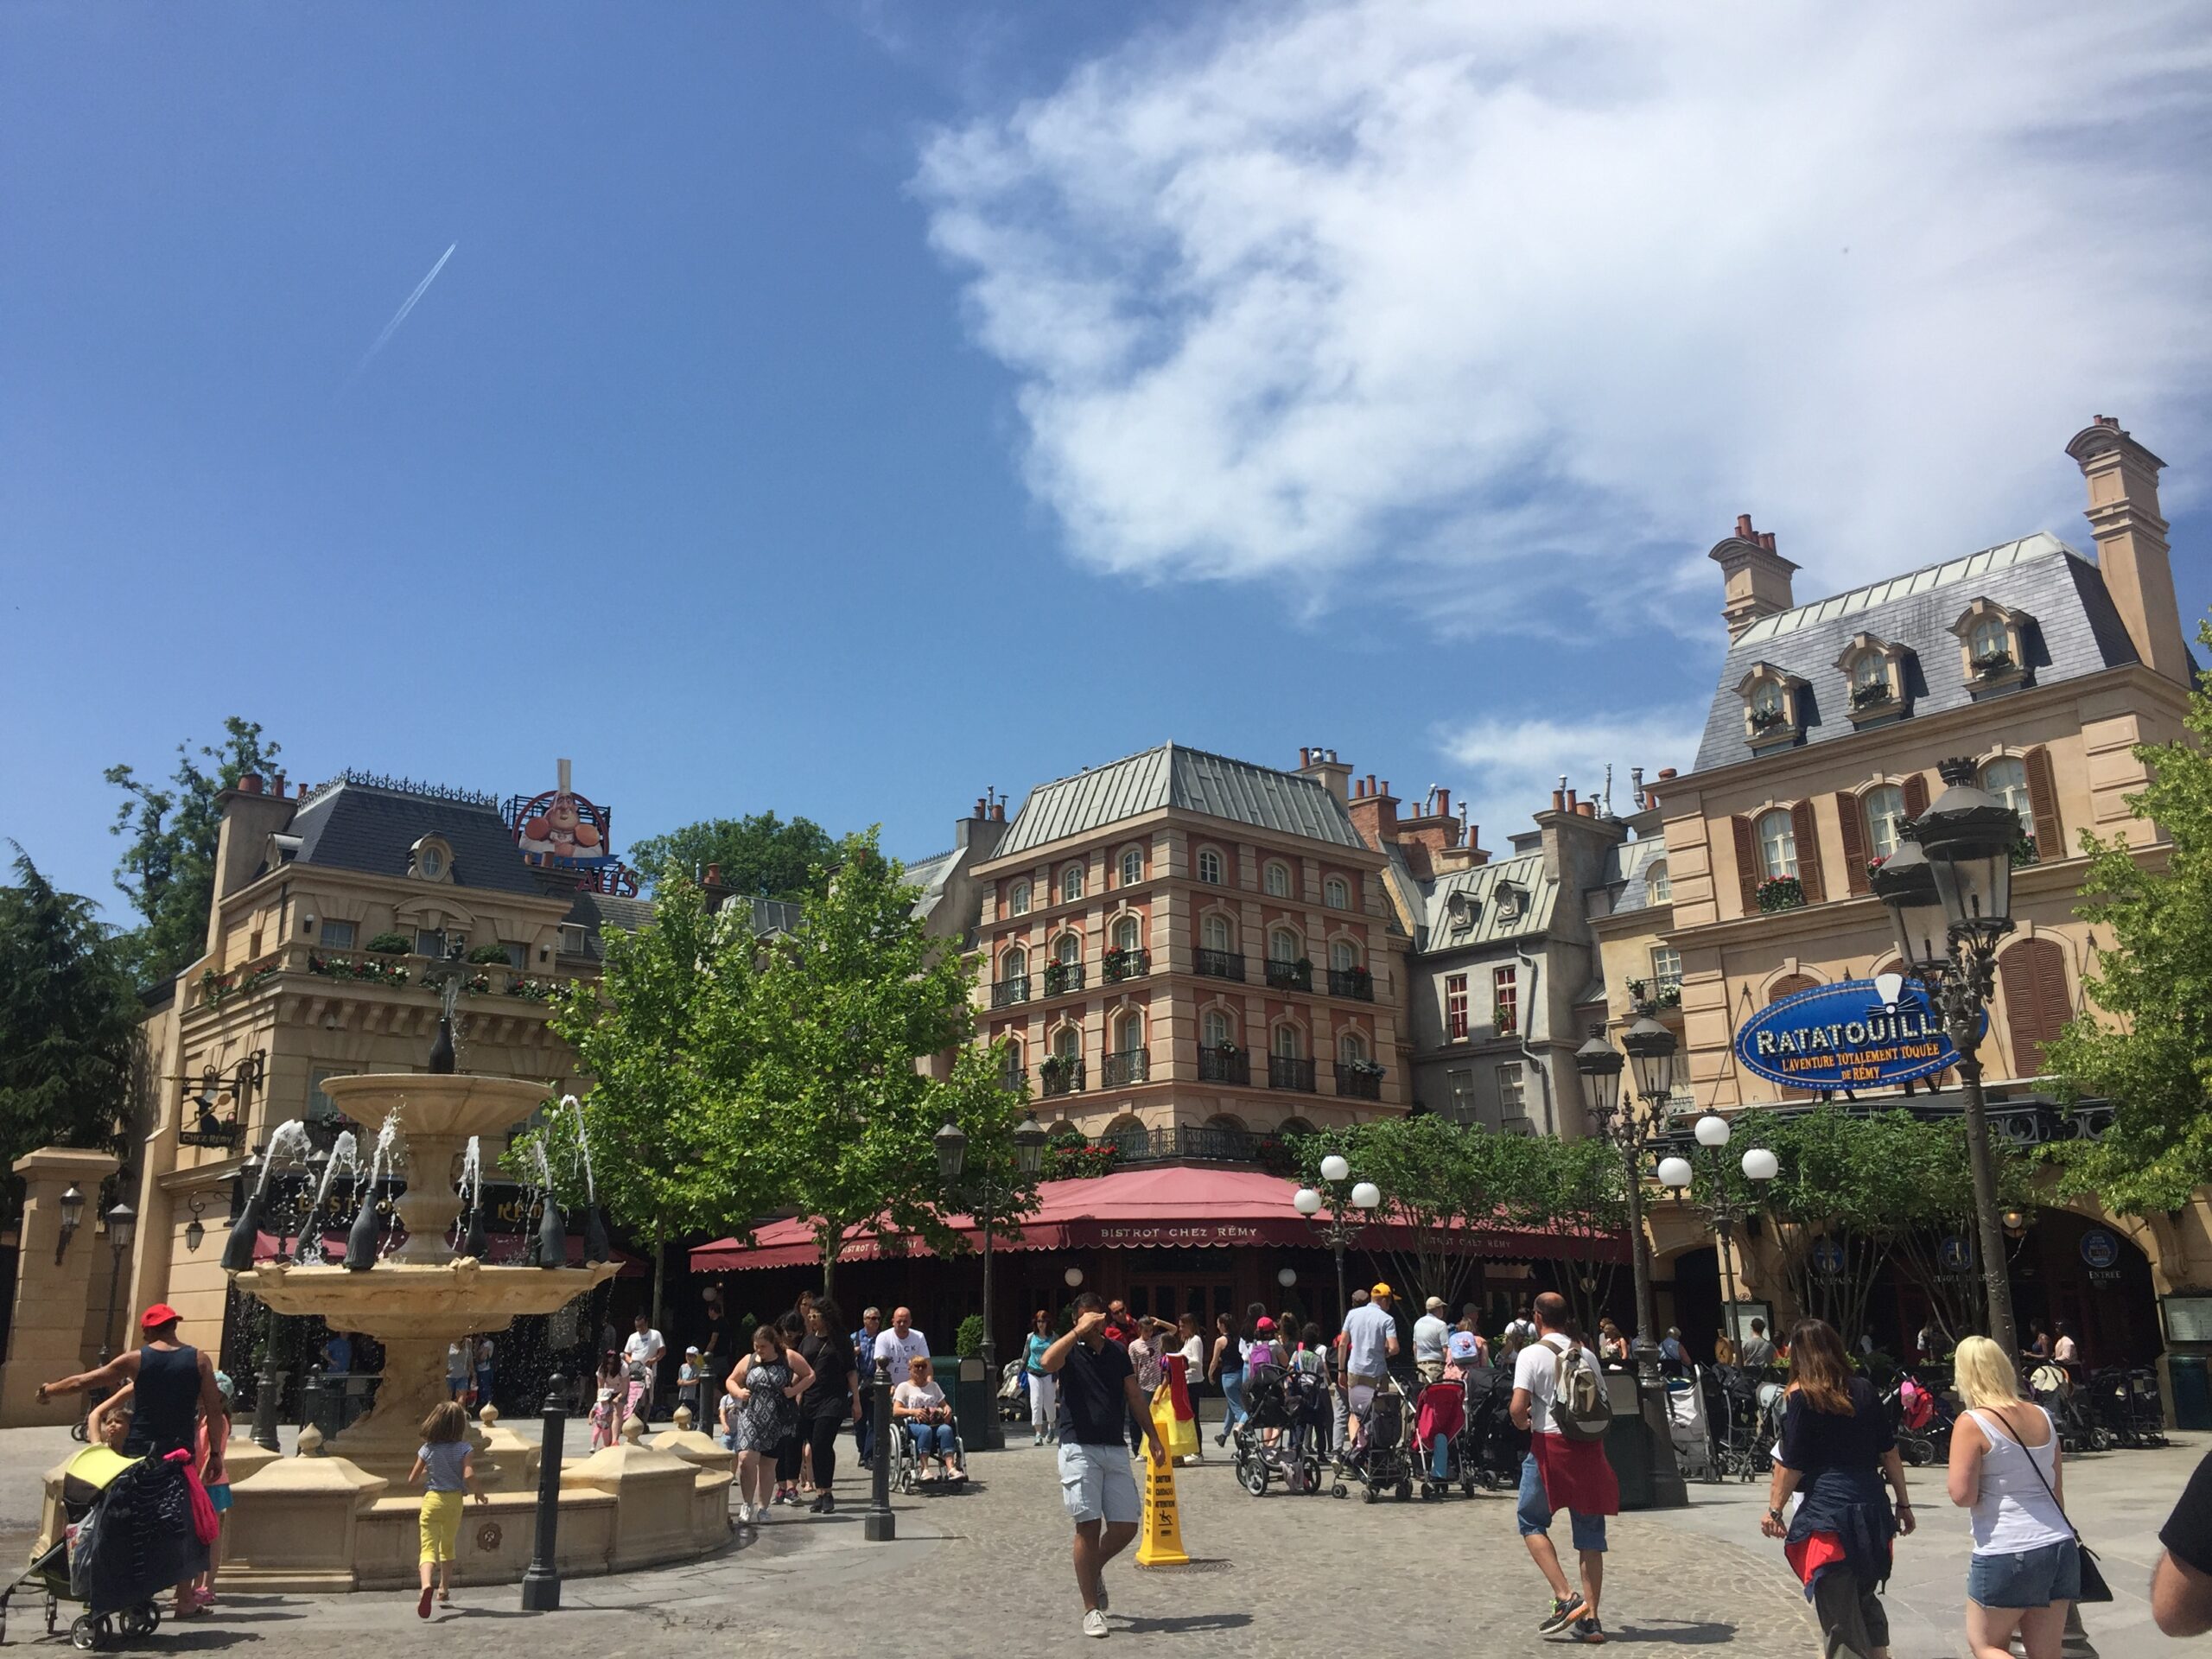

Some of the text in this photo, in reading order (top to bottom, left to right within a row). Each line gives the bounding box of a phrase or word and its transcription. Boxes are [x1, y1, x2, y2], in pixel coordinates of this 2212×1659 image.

[1757, 1013, 1951, 1054] RATATOUILL
[1783, 1040, 1940, 1072] L'AVENTURE TOTALEMENT TOQUÉE
[1853, 1065, 1881, 1080] RÉMY
[1101, 1228, 1160, 1237] BISTROT
[1217, 1225, 1258, 1236] RÉMY
